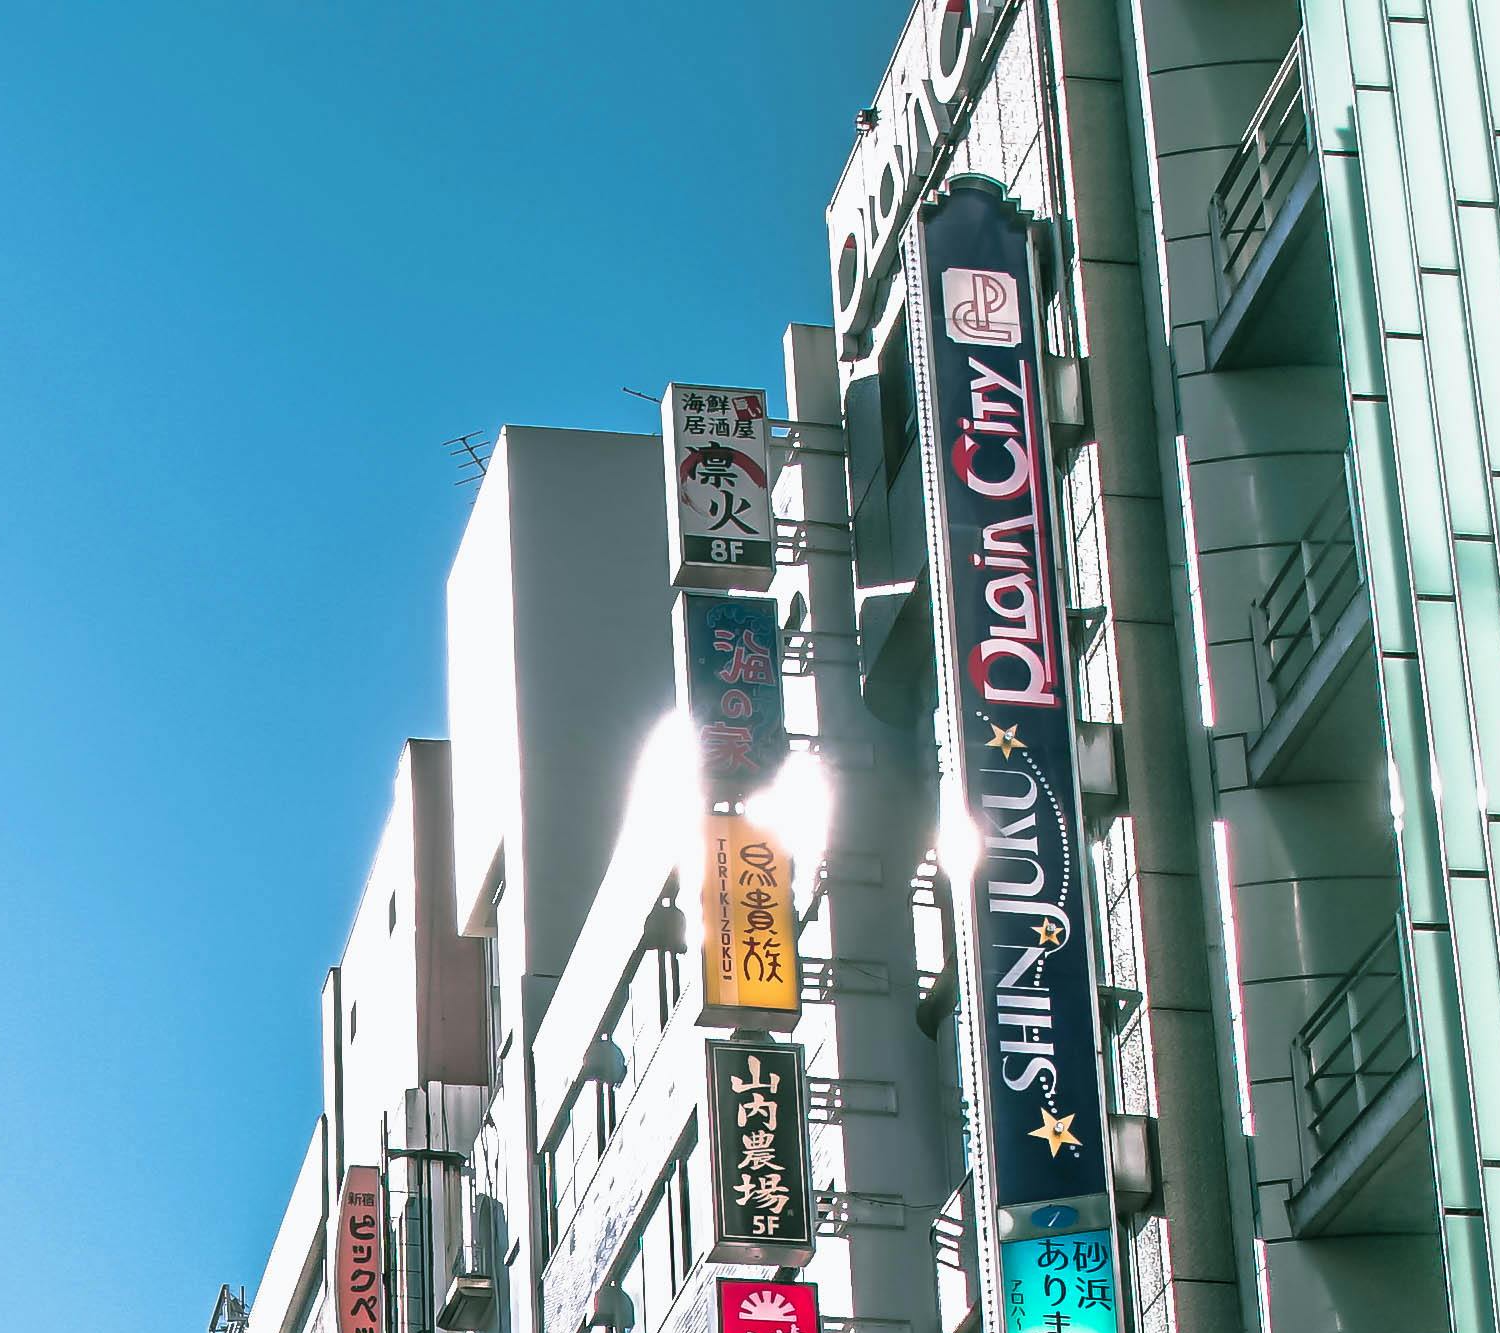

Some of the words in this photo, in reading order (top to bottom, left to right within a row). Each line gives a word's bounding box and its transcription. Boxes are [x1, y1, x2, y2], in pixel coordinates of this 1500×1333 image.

[681, 392, 732, 416] 海鮮
[684, 415, 757, 440] 居酒屋
[952, 358, 1035, 500] City
[710, 539, 744, 563] 8F
[716, 837, 733, 975] TORIKIZOKU
[983, 768, 1070, 1096] SHINJUKU
[730, 1055, 790, 1214] 山内農場
[347, 1191, 378, 1209] 新宿
[752, 1215, 780, 1236] 5F
[1072, 1240, 1113, 1312] 砂浜
